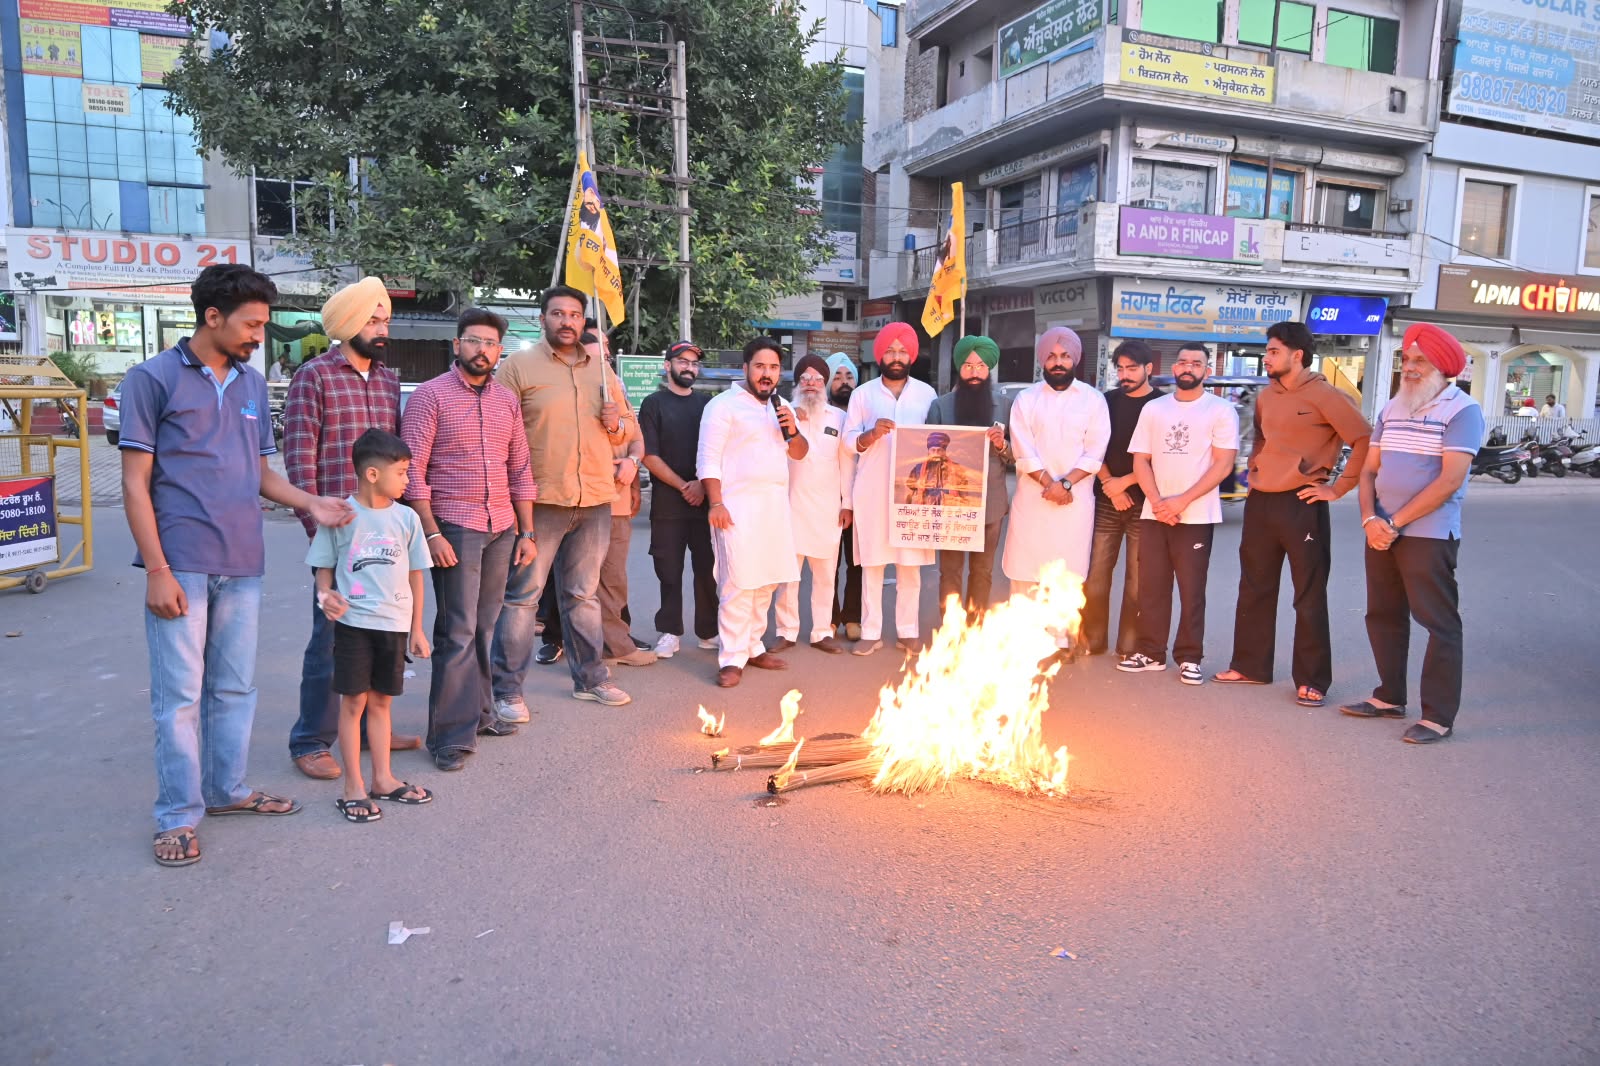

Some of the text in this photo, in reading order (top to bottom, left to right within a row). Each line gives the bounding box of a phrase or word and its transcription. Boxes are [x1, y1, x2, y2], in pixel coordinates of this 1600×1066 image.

[1138, 47, 1171, 64] ਹੋਮ ਲੋਨ
[1173, 71, 1189, 85] ਲੋਨ
[1213, 62, 1266, 79] ਪਰਸਨਲ ਲੋਨ
[1250, 83, 1266, 97] ਲੋਨ
[1460, 73, 1568, 114] 98887-48320
[1184, 132, 1228, 148] Fincap
[1255, 177, 1281, 190] TRAING
[1127, 222, 1229, 245] R AND R FINCAP
[27, 234, 238, 267] STUDIO 21
[65, 263, 102, 271] Complete
[121, 265, 134, 273] HD
[1165, 286, 1206, 315] ਟਿਕਟ
[1474, 283, 1520, 306] APNA
[1578, 291, 1600, 312] WA
[1218, 306, 1256, 320] SEKHON
[1261, 307, 1293, 321] GROUP
[1320, 307, 1339, 321] SBI
[1365, 314, 1380, 322] ATM
[23, 493, 33, 506] ਰੂਮ
